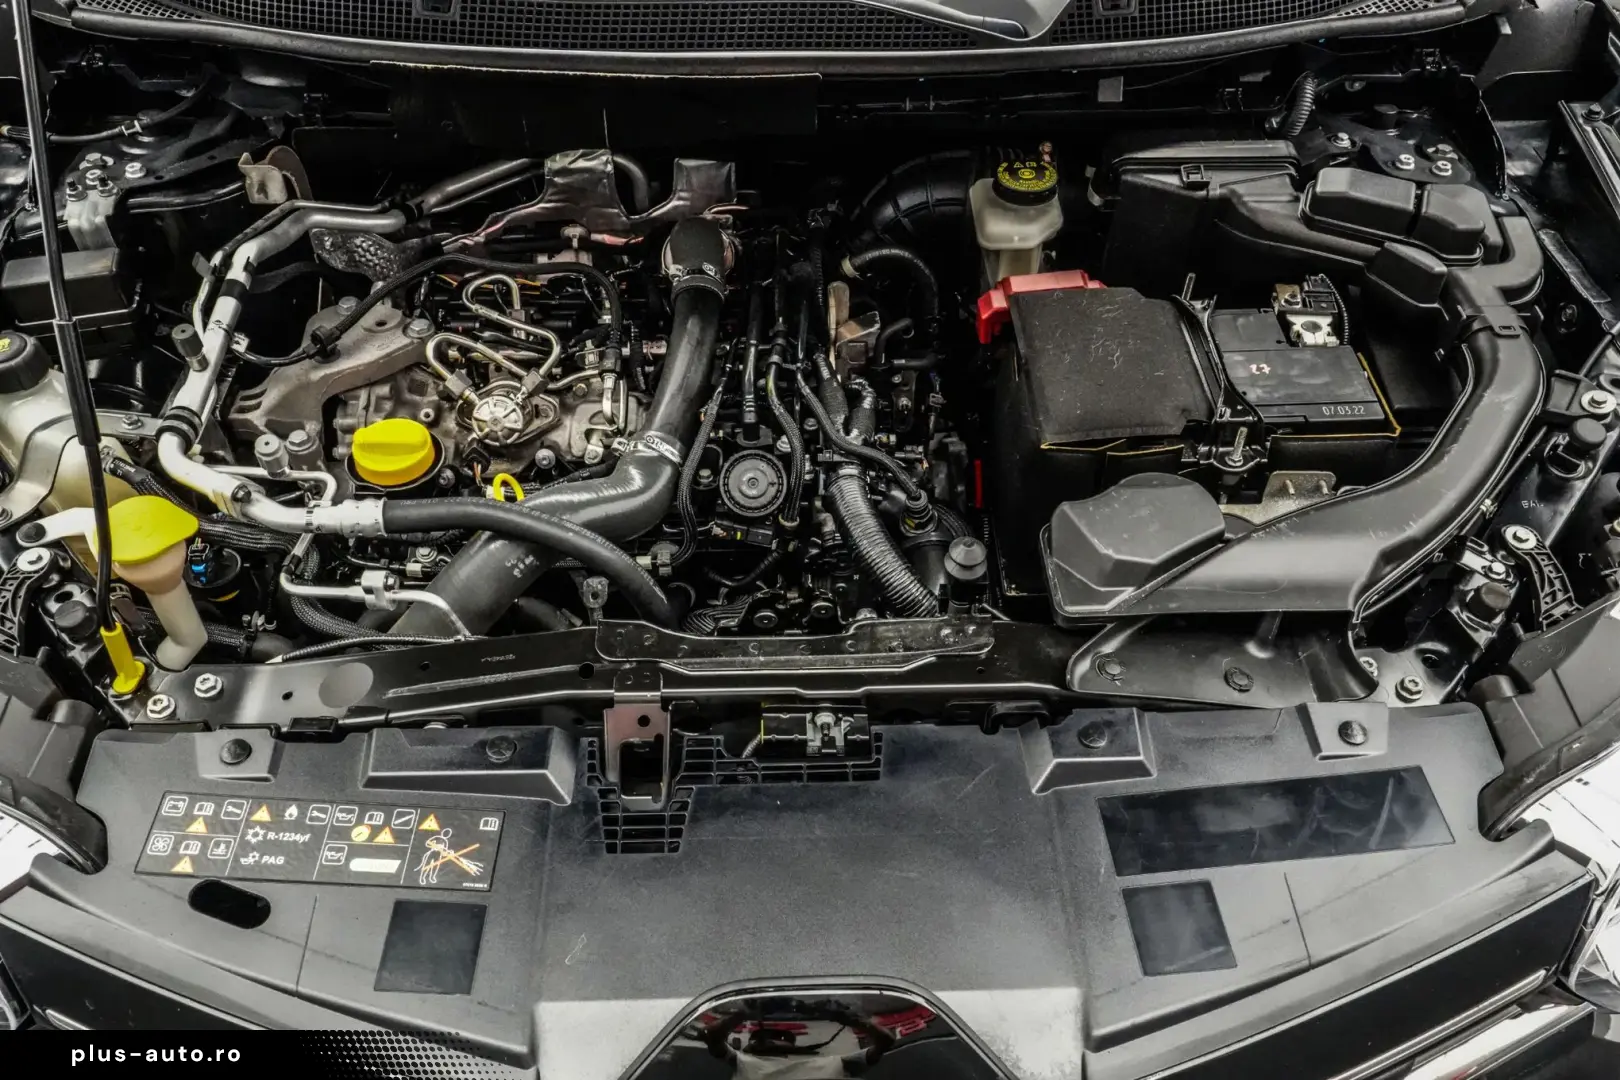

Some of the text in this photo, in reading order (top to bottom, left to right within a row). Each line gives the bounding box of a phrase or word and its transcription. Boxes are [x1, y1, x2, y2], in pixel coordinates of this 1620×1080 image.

[1322, 405, 1366, 416] 07.03.22
[266, 831, 311, 844] R-1234yf
[261, 855, 285, 865] PAG
